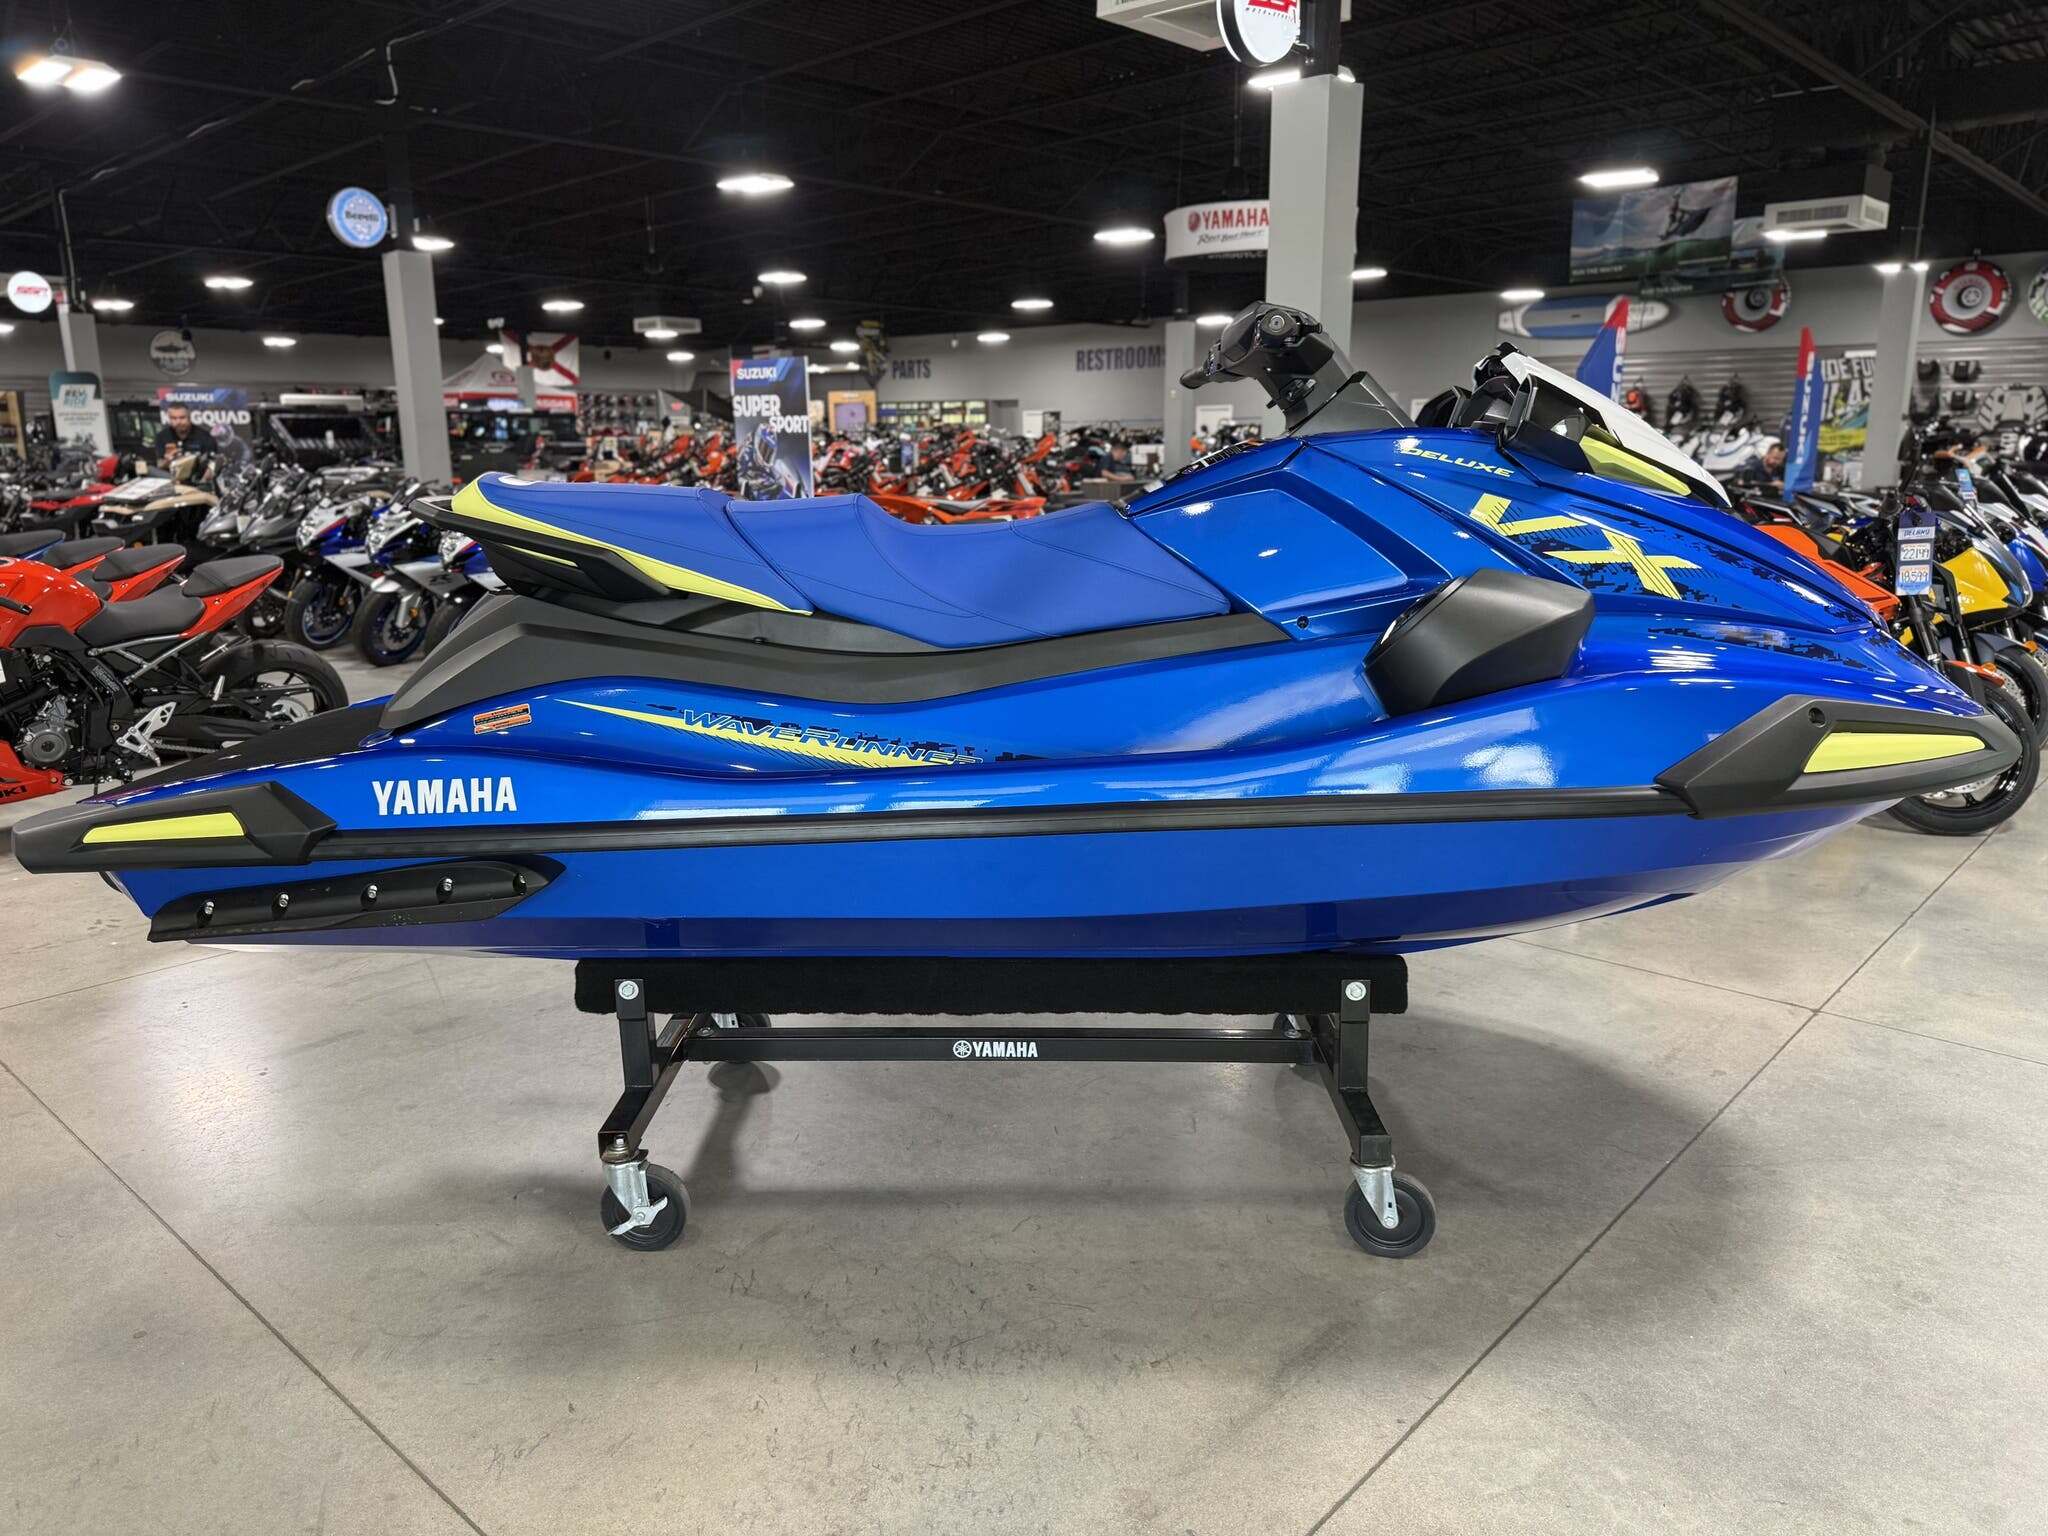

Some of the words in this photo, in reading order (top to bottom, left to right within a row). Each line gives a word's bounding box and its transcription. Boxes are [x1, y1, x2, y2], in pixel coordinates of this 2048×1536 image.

[1202, 207, 1270, 230] YAMAHA
[1076, 344, 1166, 372] RESTROOM
[737, 367, 777, 380] SUZUKI
[892, 359, 931, 379] PARTS
[1821, 358, 1851, 381] IDE
[165, 392, 214, 403] SUZUKI
[732, 394, 781, 417] SUPER
[160, 410, 251, 427] KGQUAD
[769, 415, 809, 434] SPORT
[1401, 447, 1515, 477] DELUXE
[371, 776, 518, 816] YAMAHA
[972, 1041, 1039, 1058] YAMAHA
